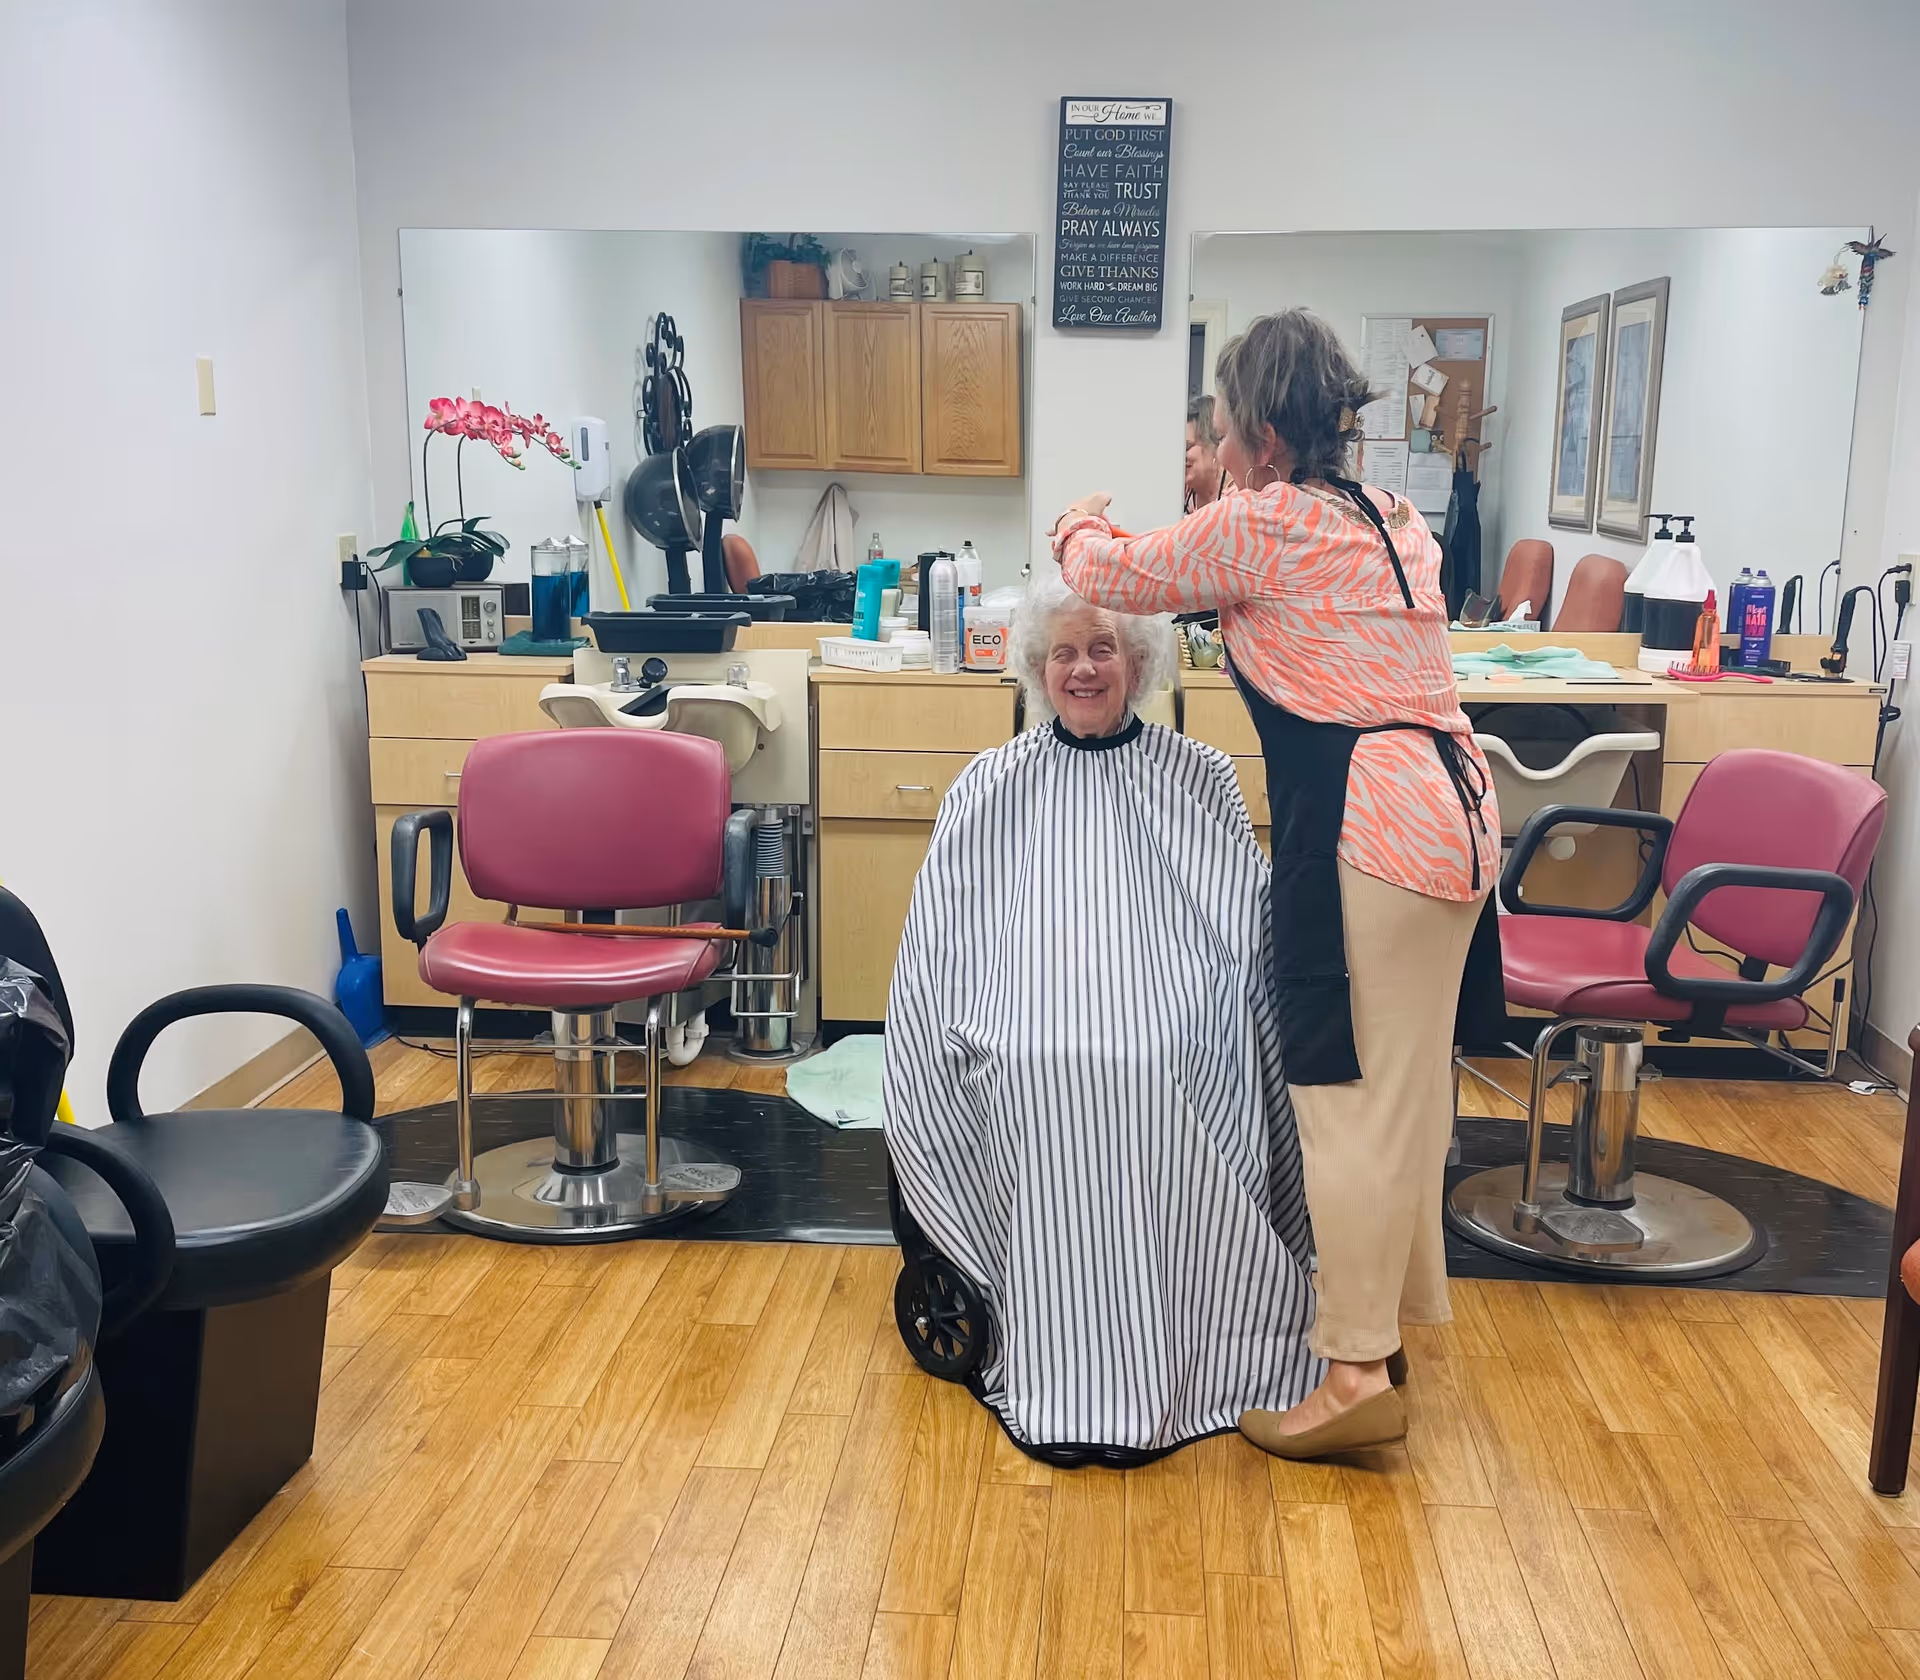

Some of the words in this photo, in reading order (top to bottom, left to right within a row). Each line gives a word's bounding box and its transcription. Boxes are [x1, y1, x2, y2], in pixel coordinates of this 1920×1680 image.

[1071, 104, 1080, 112] IN
[1082, 104, 1099, 112] OUR
[1095, 103, 1141, 123] Home
[1065, 128, 1092, 140] PUT
[1095, 129, 1125, 141] GOD
[1129, 129, 1165, 141] FIRST
[1063, 143, 1095, 159] Count
[1097, 147, 1112, 158] our
[1115, 144, 1164, 162] Blessings
[1063, 163, 1109, 178] HAVE
[1115, 164, 1164, 179] FAITH
[1063, 191, 1091, 199] THANK
[1093, 191, 1110, 199] YOU
[1114, 182, 1162, 199] TRUST
[1062, 202, 1100, 216] Believe
[1102, 206, 1111, 216] in
[1113, 202, 1160, 217] Miracles
[1061, 219, 1099, 236] PRAY
[1101, 220, 1160, 237] ALWAYS
[1060, 253, 1088, 262] MAKE
[1090, 253, 1097, 262] A
[1099, 253, 1159, 263] DIFFERENCE
[1060, 264, 1095, 278] GIVE
[1097, 265, 1159, 279] THANKS
[1060, 281, 1082, 291] WORK
[1084, 281, 1105, 291] HARD
[1117, 282, 1144, 292] DREAM
[1145, 282, 1158, 292] BIG
[1060, 295, 1079, 303] GIVE
[1081, 295, 1116, 303] SECOND
[1117, 296, 1158, 304] CHANCES
[1058, 304, 1087, 325] Love
[1089, 306, 1113, 323] One
[1115, 306, 1157, 323] Another
[973, 635, 1001, 645] ECO
